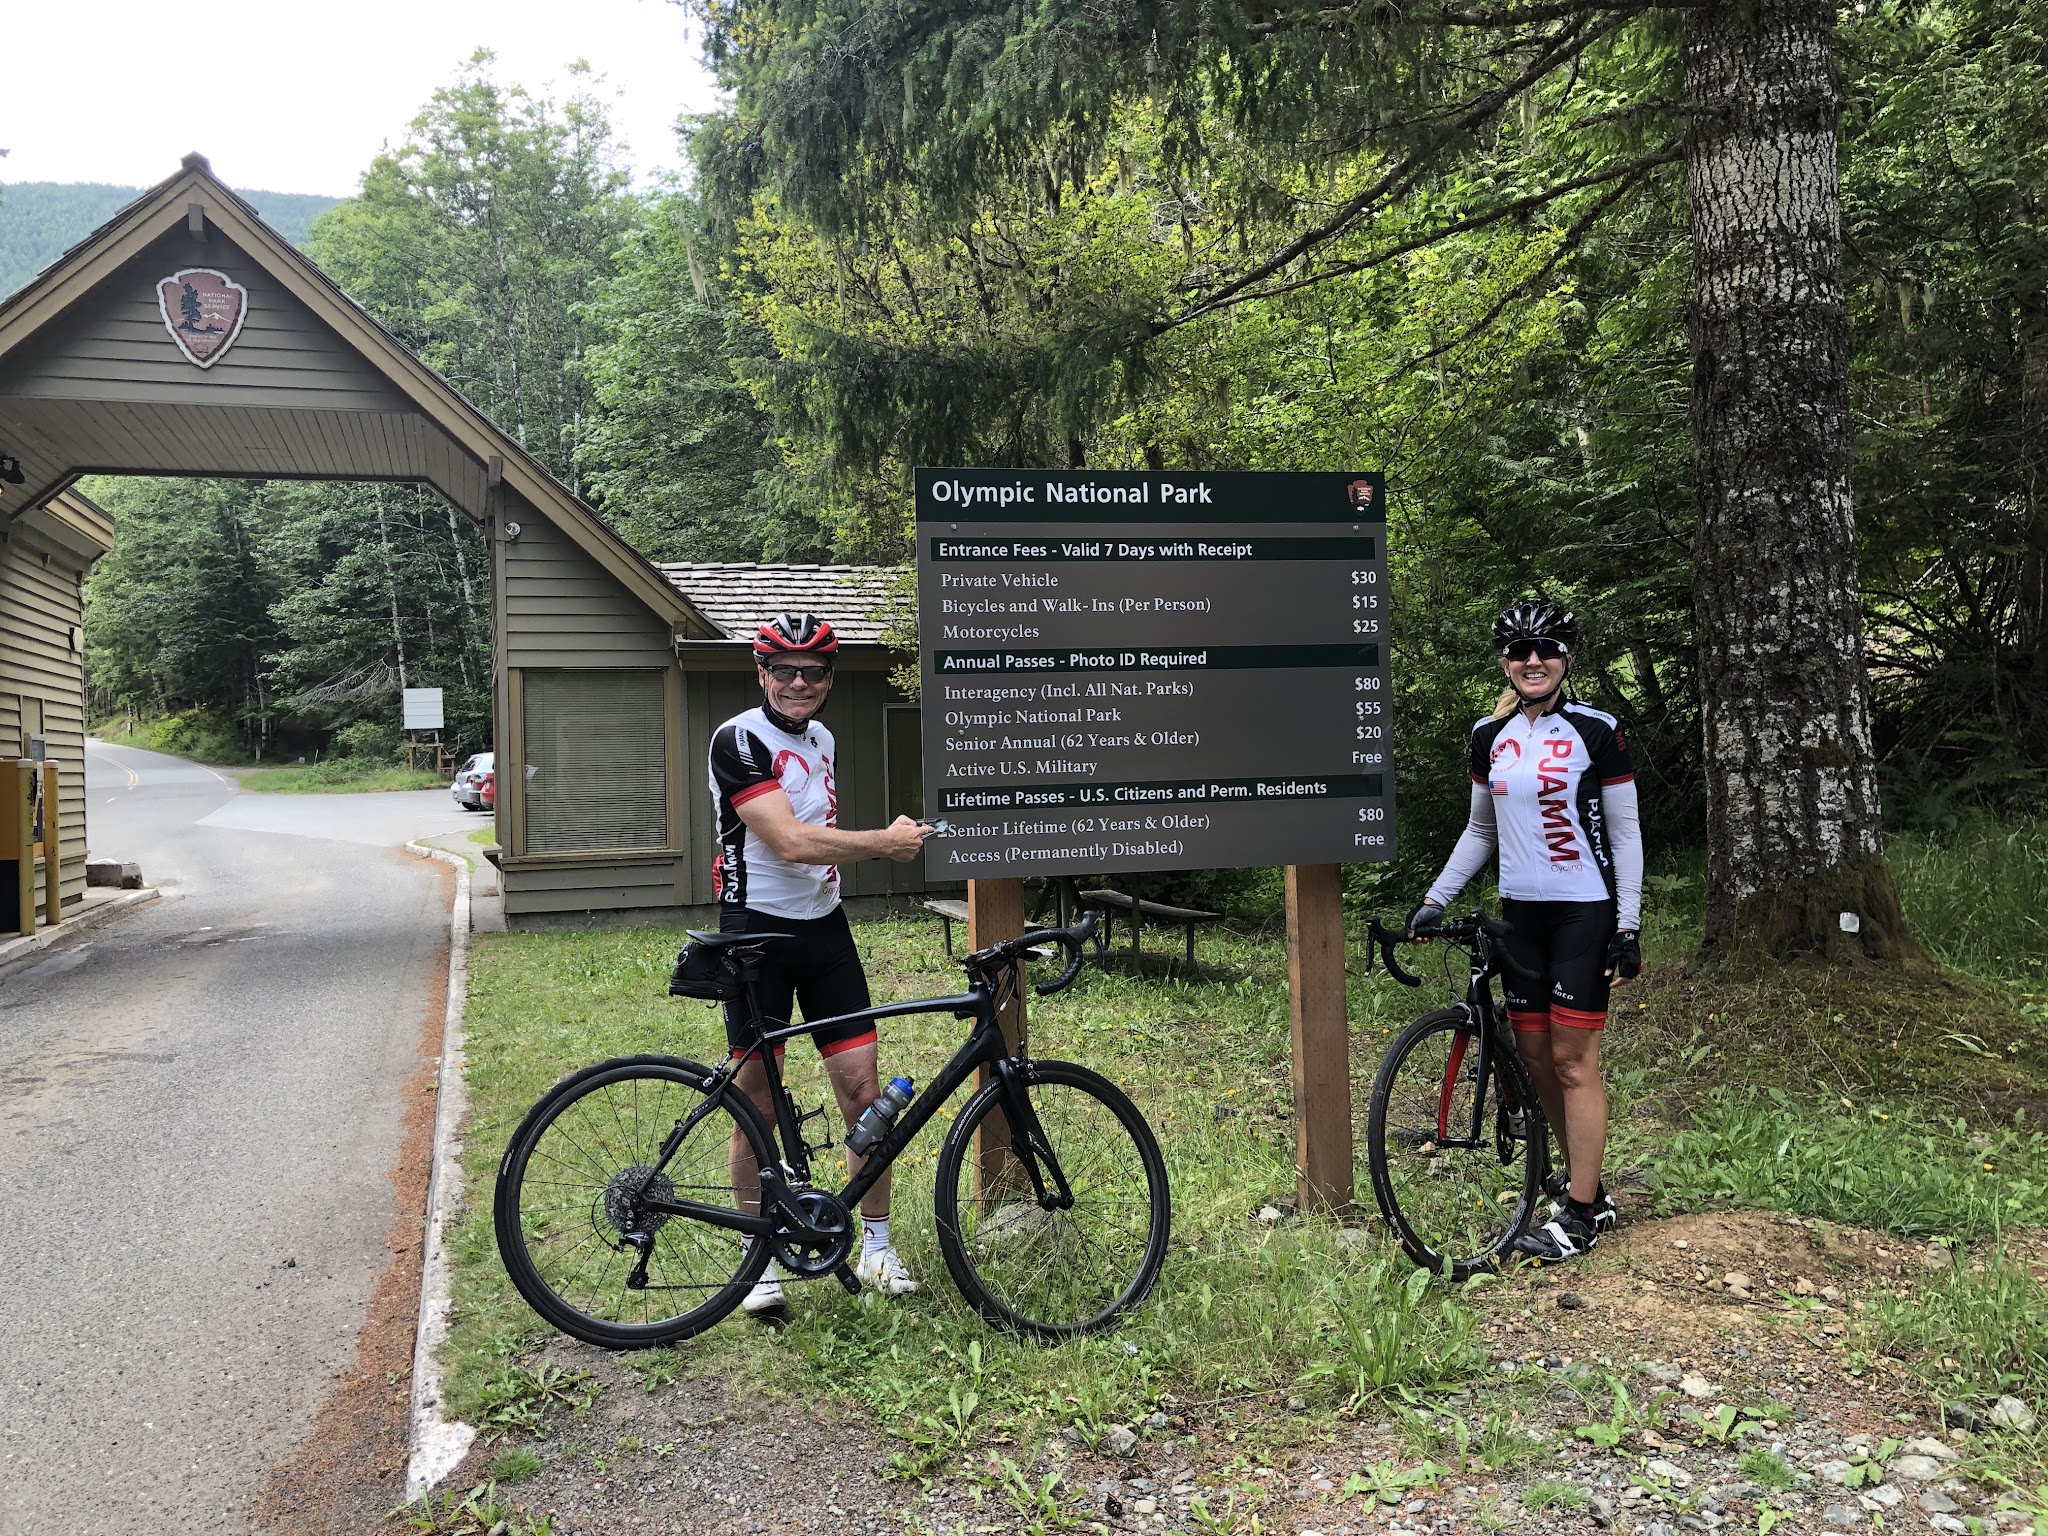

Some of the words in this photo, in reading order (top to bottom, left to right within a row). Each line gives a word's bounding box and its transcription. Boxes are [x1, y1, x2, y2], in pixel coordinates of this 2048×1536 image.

[932, 479, 1035, 508] Olympic
[1046, 481, 1149, 504] National
[1160, 481, 1213, 504] Park
[939, 542, 1009, 557] Entrance
[1013, 543, 1048, 557] Fees
[1061, 542, 1100, 557] Valid
[1104, 543, 1114, 557] 7
[1118, 543, 1155, 560] Days
[1158, 542, 1194, 557] with
[1198, 542, 1253, 560] Receipt
[940, 573, 997, 587] Private
[1000, 572, 1059, 587] Vehicle
[1351, 570, 1377, 586] $30
[941, 598, 1006, 617] Bicycles
[1009, 598, 1038, 613] and
[1118, 598, 1151, 614] (Per
[1153, 597, 1211, 614] Person)
[1352, 594, 1378, 610] $15
[942, 623, 1040, 642] Motorcycles
[1352, 618, 1379, 634] $25
[943, 653, 1001, 670] Annual
[1005, 654, 1056, 669] Passes
[1069, 652, 1115, 667] Photo
[1119, 652, 1136, 667] ID
[1140, 650, 1207, 669] Required
[944, 686, 1037, 703] Interagency
[1040, 683, 1081, 701] (Incl.
[1084, 682, 1107, 697] All
[1110, 682, 1142, 696] Nat.
[1146, 681, 1194, 698] Parks)
[1354, 676, 1381, 692] $80
[1355, 700, 1381, 717] $55
[945, 710, 1012, 729] Olympic
[1015, 708, 1083, 724] National
[1085, 707, 1122, 722] Park
[945, 736, 997, 751] Senior
[1000, 734, 1057, 750] Annual
[1060, 733, 1084, 751] (62
[1087, 733, 1130, 747] Years
[1133, 732, 1148, 746] &
[1150, 730, 1200, 747] Older)
[1356, 725, 1382, 740] $20
[1352, 750, 1383, 764] Free
[945, 762, 996, 777] Active
[999, 760, 1031, 775] U.S.
[1035, 759, 1098, 776] Military
[946, 791, 1011, 808] Lifetime
[1015, 791, 1065, 805] Passes
[1079, 788, 1110, 803] U.S.
[1114, 786, 1174, 801] Citizens
[1177, 784, 1206, 799] and
[1210, 784, 1253, 798] Perm.
[1256, 781, 1327, 796] Residents
[1537, 738, 1581, 862] PJAMM
[1358, 807, 1384, 823] $80
[948, 822, 999, 838] Senior
[1002, 820, 1067, 836] Lifetime
[1071, 818, 1095, 836] (62
[1097, 817, 1141, 832] Years
[1144, 816, 1158, 830] &
[1161, 814, 1210, 830] Older)
[1354, 833, 1385, 846] Free
[948, 849, 1001, 864] Access
[1004, 843, 1109, 864] (Permanently
[1111, 839, 1184, 856] Disabled)
[1551, 863, 1584, 874] Cycling
